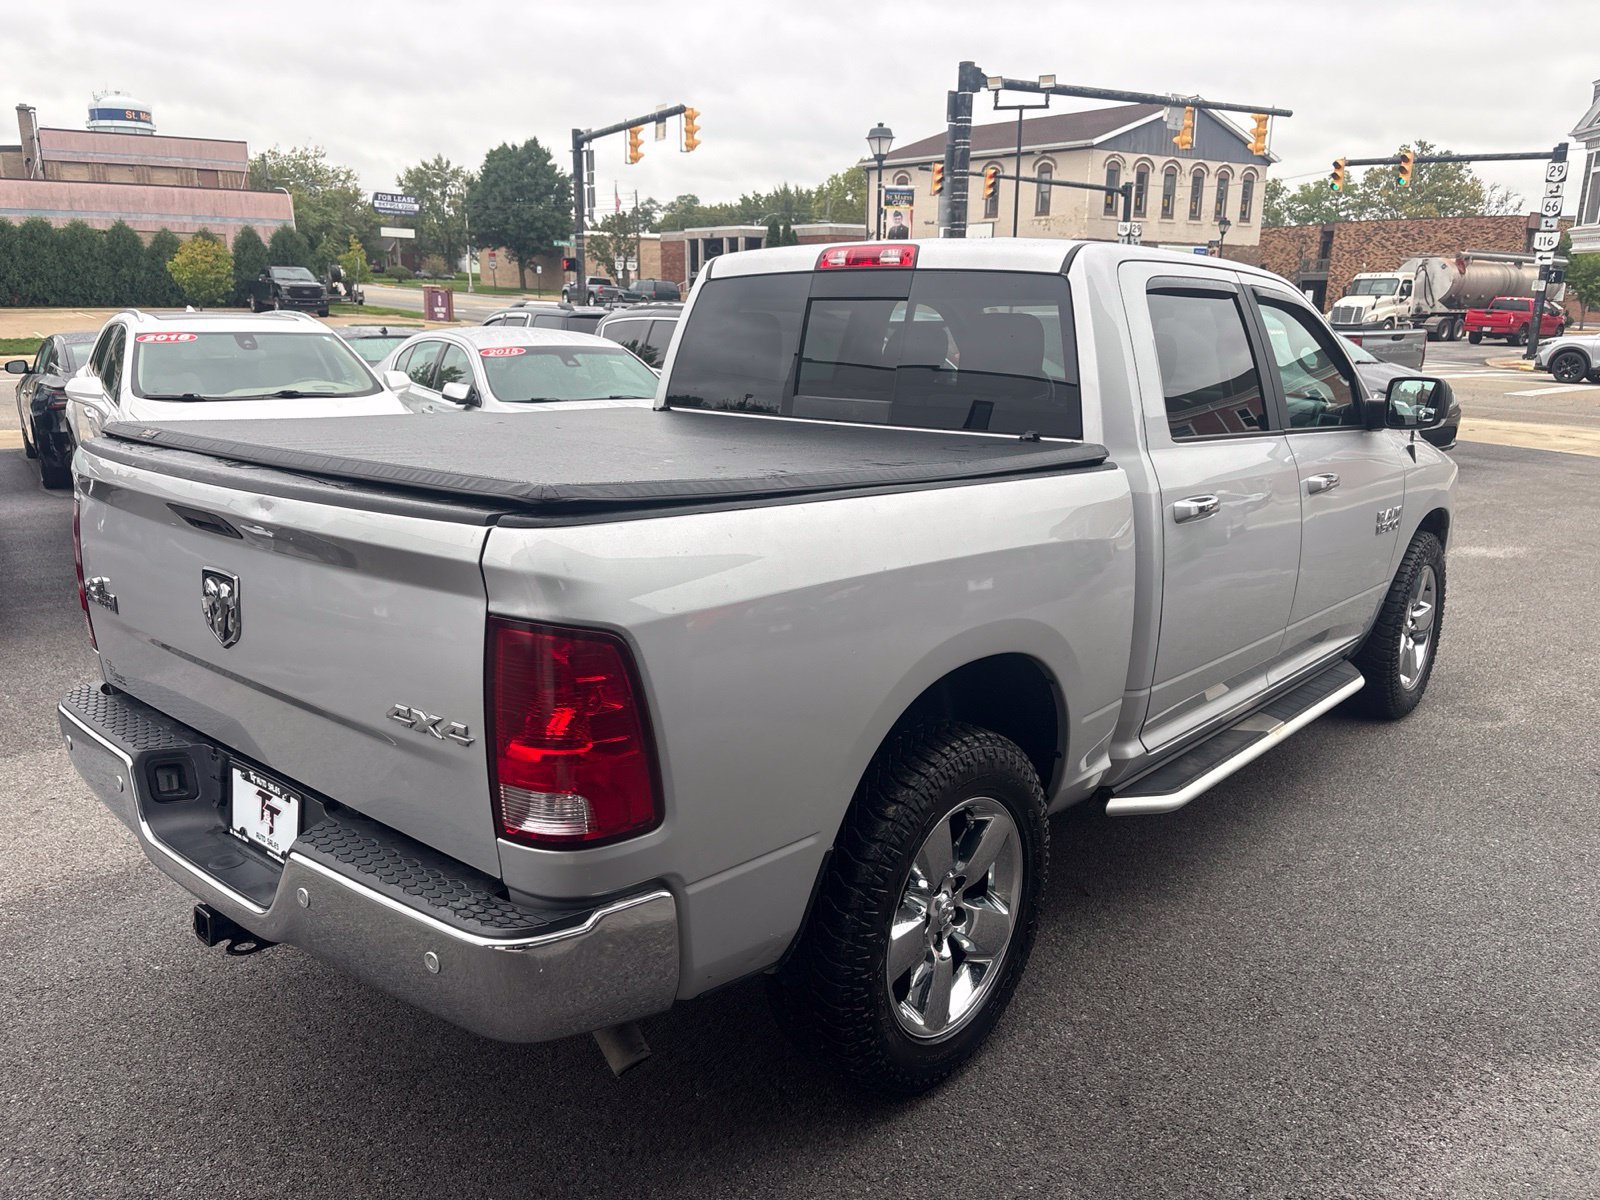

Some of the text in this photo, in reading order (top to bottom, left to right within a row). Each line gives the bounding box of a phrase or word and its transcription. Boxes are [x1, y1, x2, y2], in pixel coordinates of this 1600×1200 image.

[1549, 165, 1564, 178] 29
[378, 193, 416, 204] FOR LEASE
[1544, 200, 1559, 213] 66
[1132, 224, 1142, 233] 29
[1538, 236, 1554, 247] 116
[1376, 505, 1402, 524] RAM
[1375, 518, 1400, 536] 1500
[267, 783, 281, 795] SALES
[256, 832, 267, 843] AUTO
[267, 838, 280, 851] SALES
